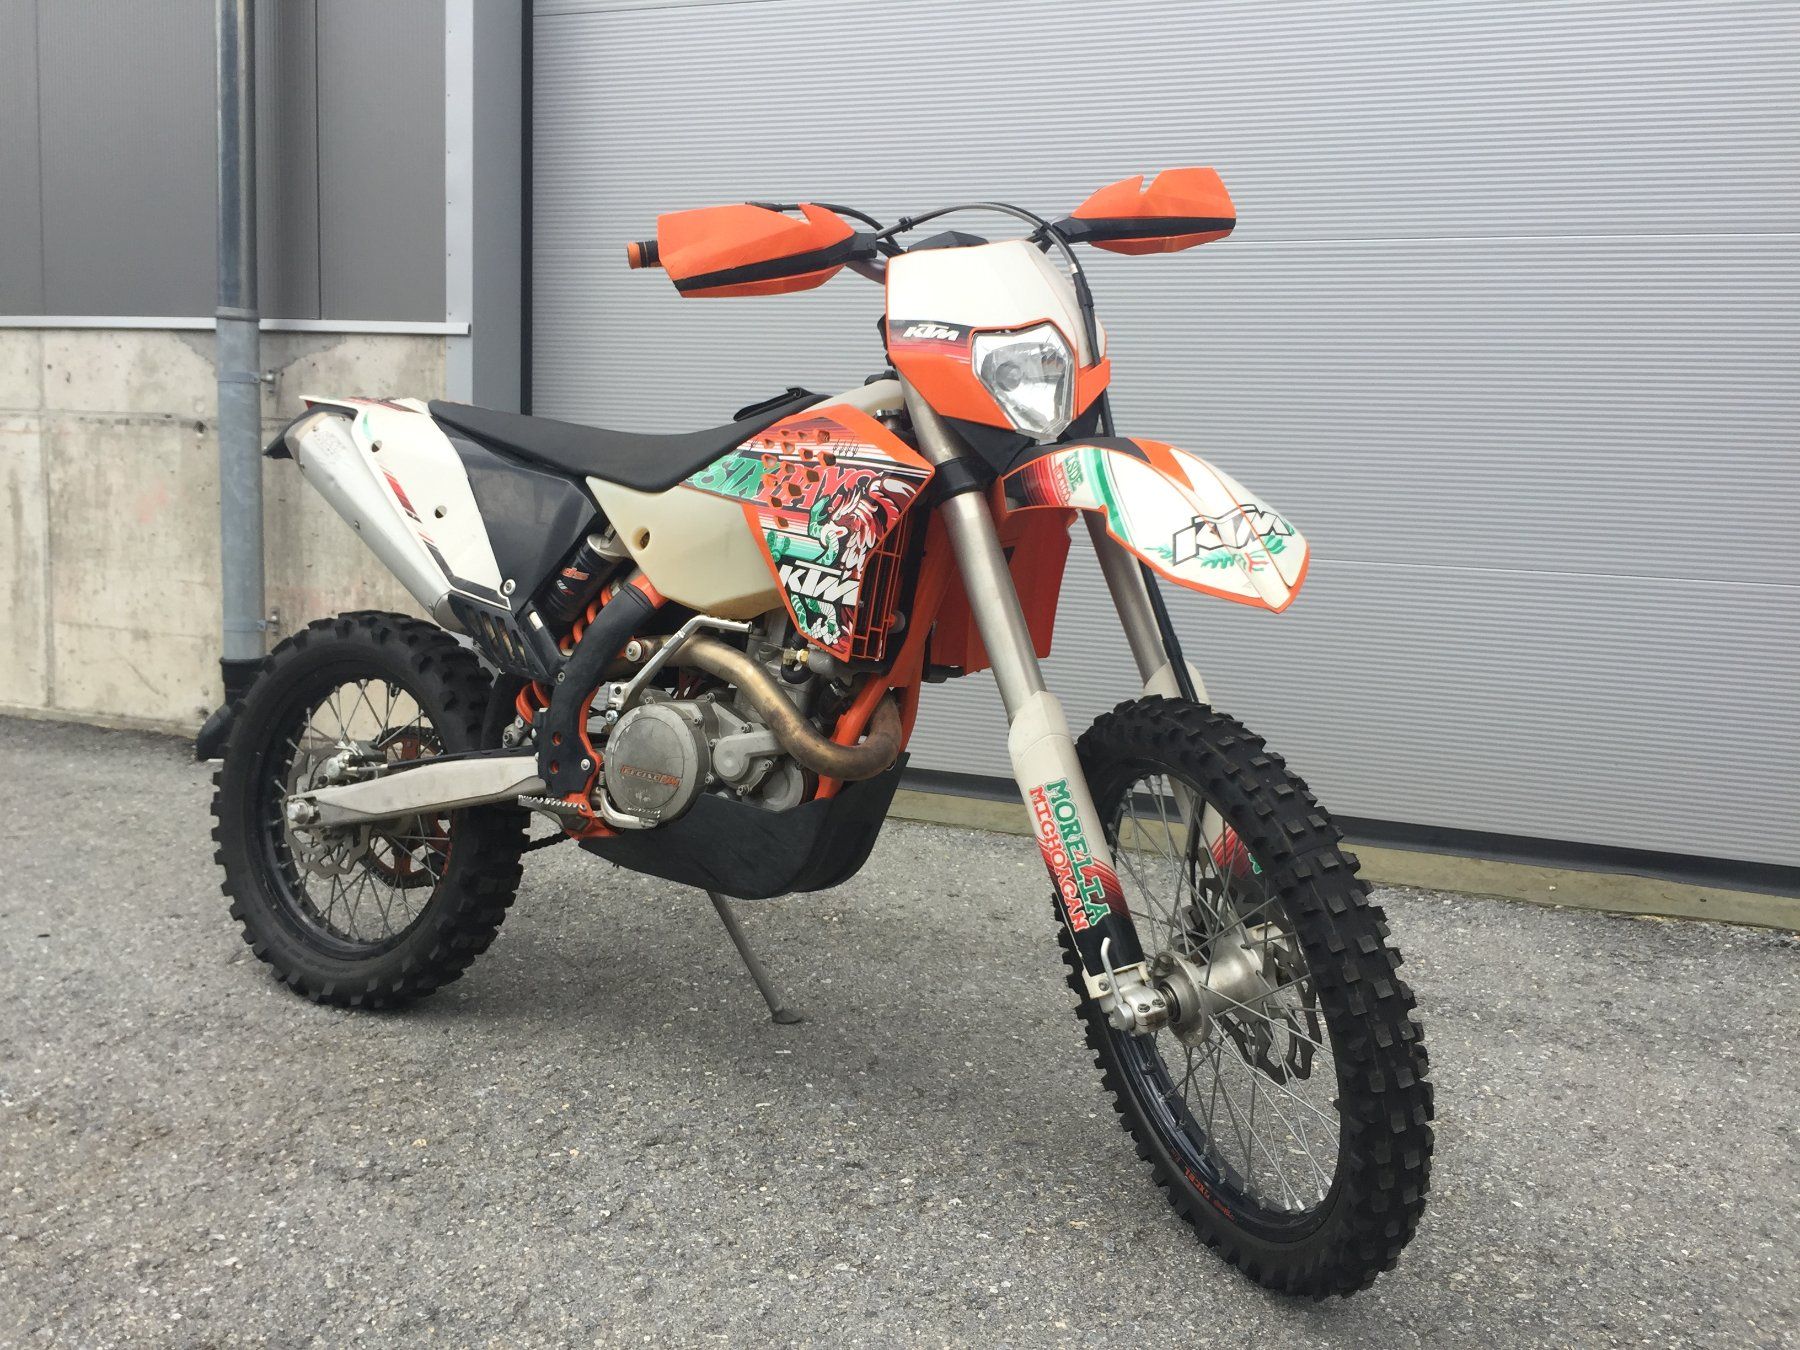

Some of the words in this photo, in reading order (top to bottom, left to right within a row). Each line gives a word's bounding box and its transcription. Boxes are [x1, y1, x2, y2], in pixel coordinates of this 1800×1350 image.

[902, 322, 960, 342] KTM
[1172, 503, 1293, 567] KTM
[778, 559, 861, 607] KTM
[1028, 785, 1091, 932] MICHOACAN
[1046, 777, 1112, 926] MORELIA
